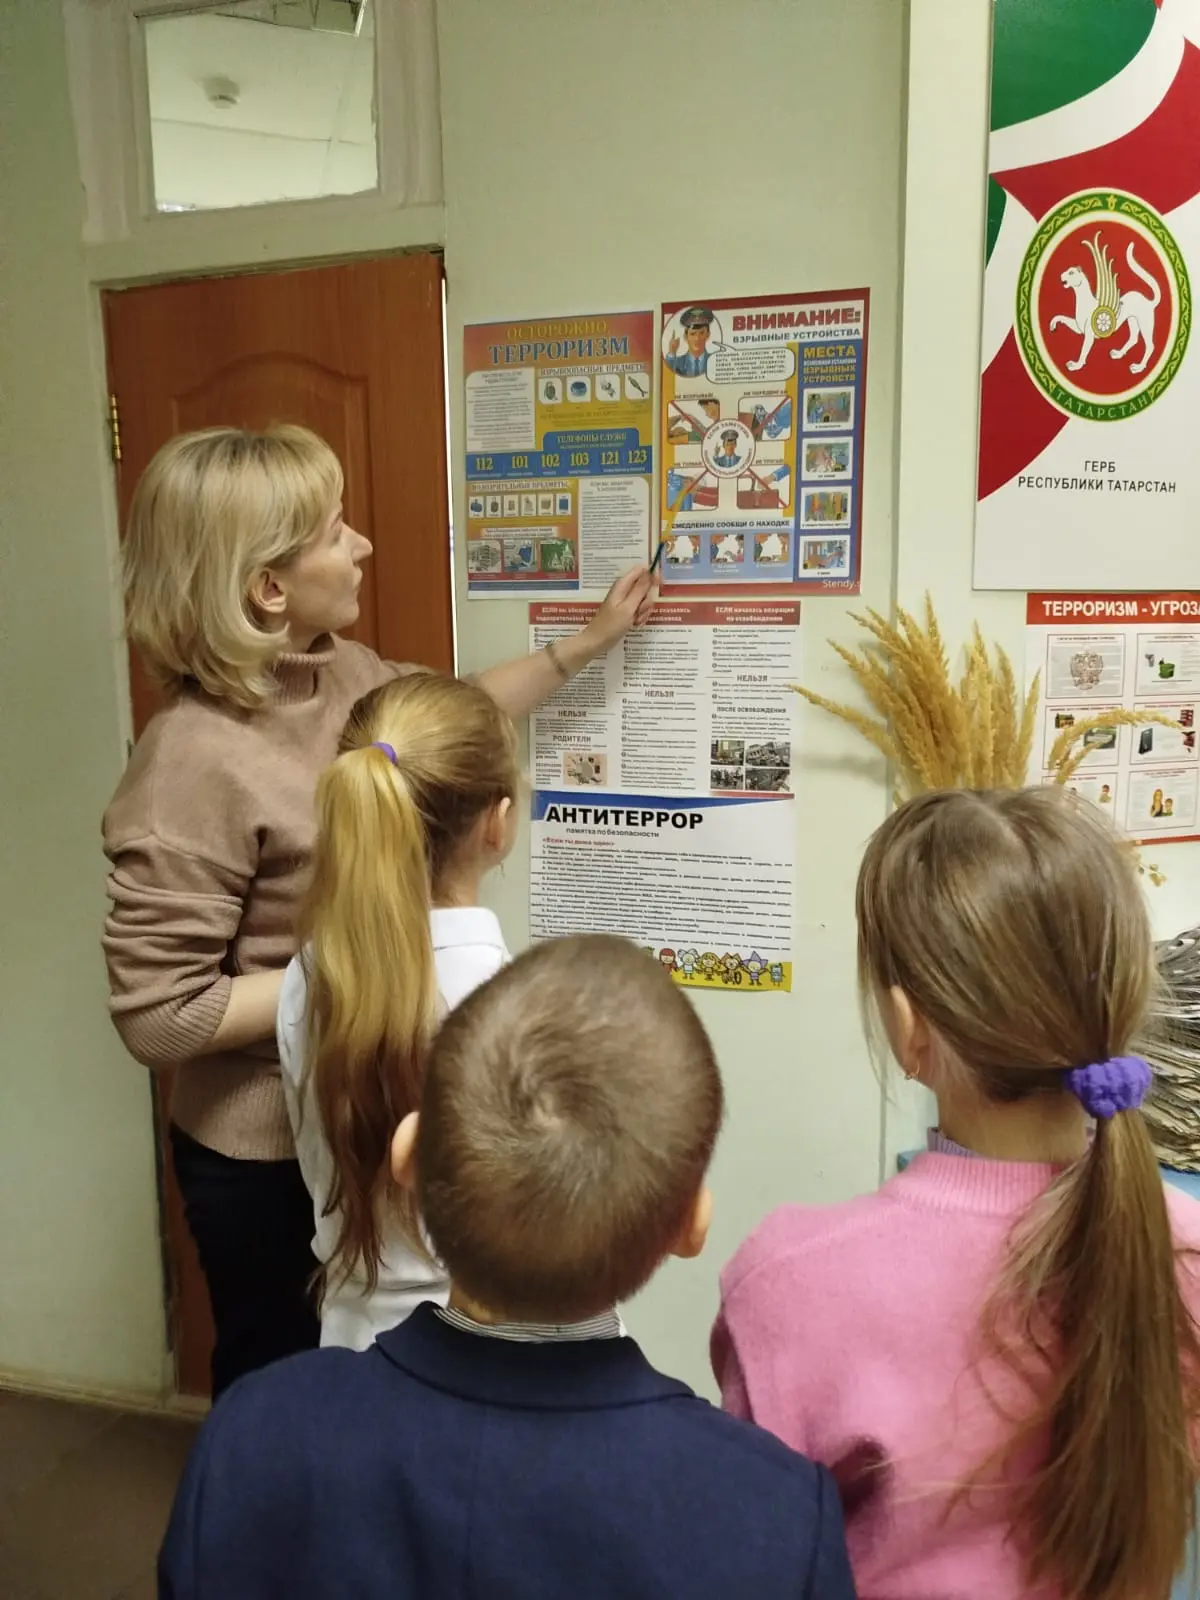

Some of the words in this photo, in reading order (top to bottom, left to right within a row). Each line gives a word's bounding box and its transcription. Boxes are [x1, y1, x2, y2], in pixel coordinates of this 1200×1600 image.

[733, 332, 791, 344] ВЗРЫВНЫЕ
[793, 328, 860, 340] УСТРОЙСТВА
[488, 336, 629, 365] ТЕРРОРИЗМ
[803, 345, 856, 359] МЕСТА
[1055, 390, 1147, 418] ТАТАРСТАН
[476, 457, 494, 471] 112
[511, 455, 529, 469] 101
[541, 454, 560, 468] 102
[569, 452, 589, 466] 103
[600, 451, 619, 465] 121
[627, 450, 647, 464] 123
[1084, 460, 1116, 473] ГЕРБ
[1018, 476, 1104, 491] РЕСПУБЛИКИ
[1107, 480, 1176, 493] ТАТАРСТАН
[671, 521, 714, 530] ЕМЕДЛЕННО
[716, 521, 747, 529] СООБЩИ
[757, 520, 790, 528] НАХОДКЕ
[1042, 600, 1138, 616] ТЕРРОРИЗМ
[1150, 600, 1200, 616] УГРОЗ
[737, 674, 767, 682] НЕЛЬЗЯ
[645, 690, 674, 698] НЕЛЬЗЯ
[558, 710, 587, 718] НЕЛЬЗЯ
[553, 734, 592, 743] РОДИТЕЛИ
[546, 806, 703, 829] АНТИТЕРРОР
[566, 827, 596, 835] памятка
[597, 829, 606, 837] по
[607, 829, 660, 839] безопасности
